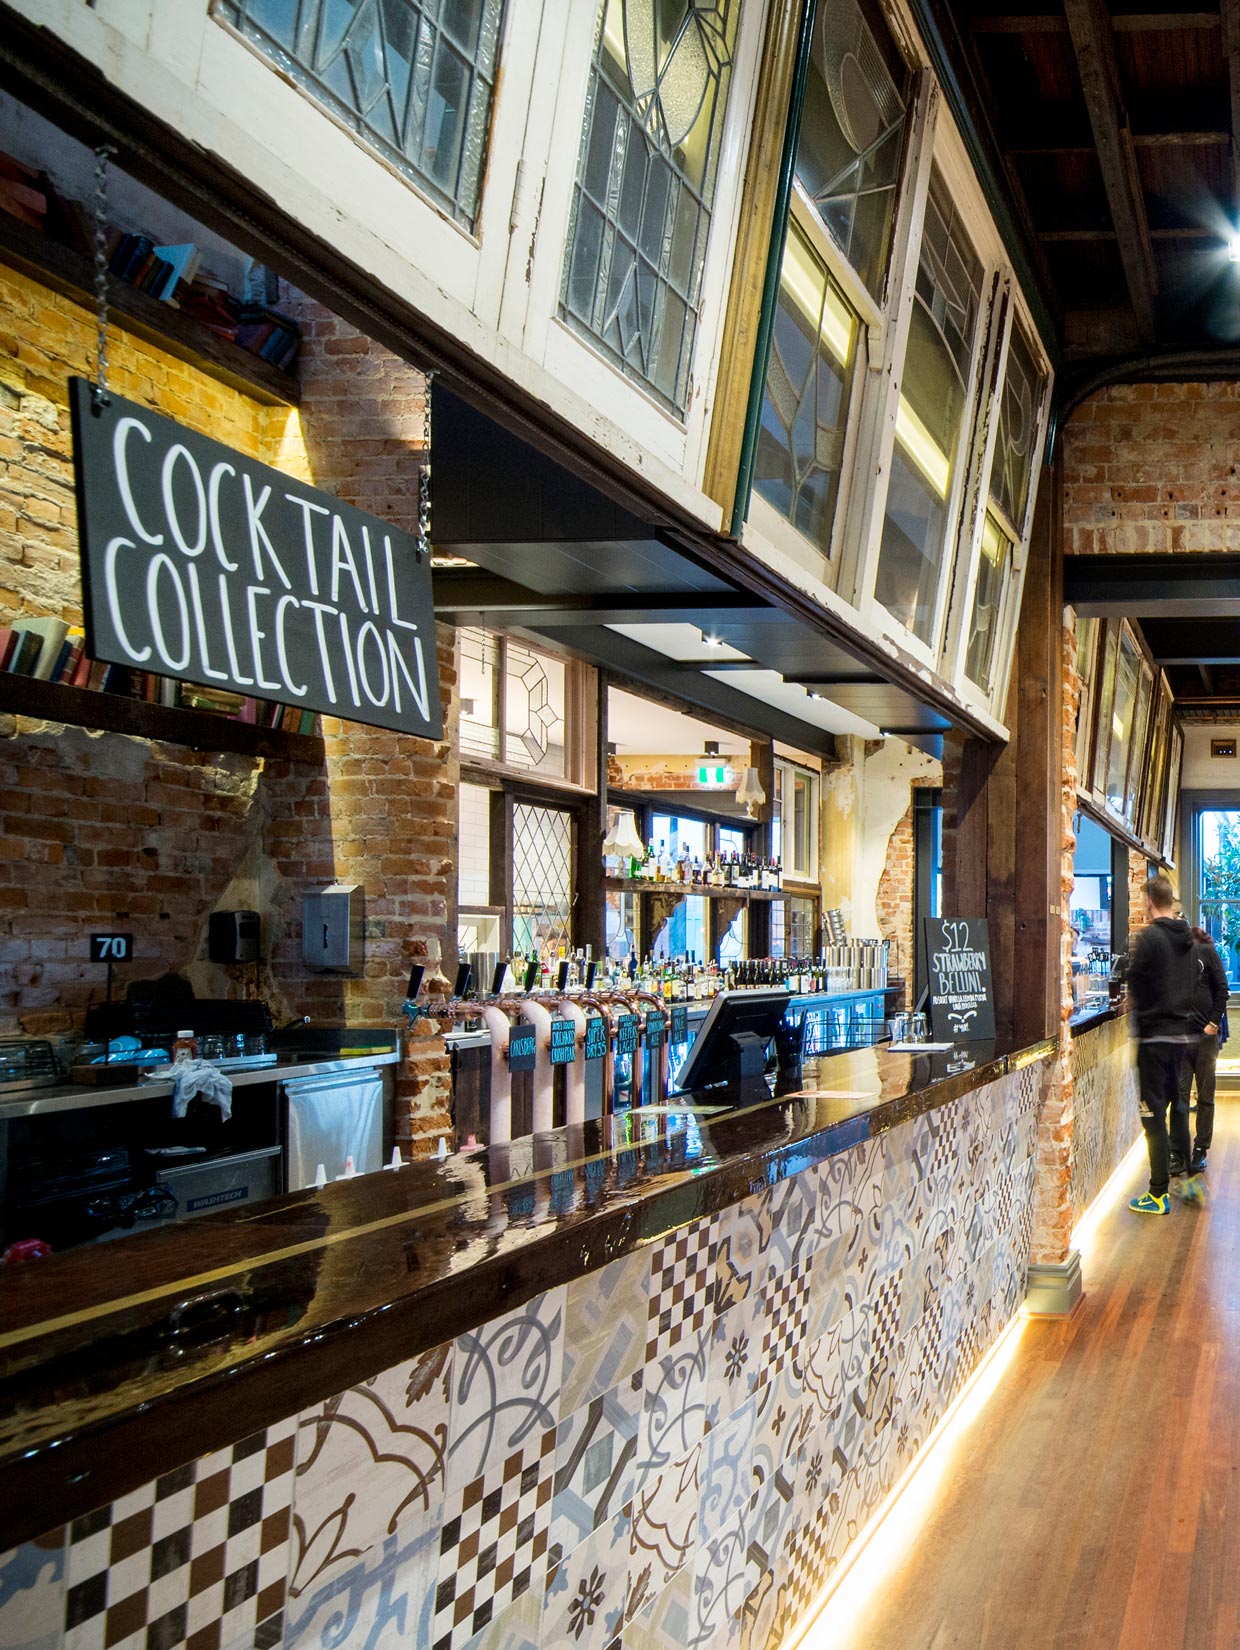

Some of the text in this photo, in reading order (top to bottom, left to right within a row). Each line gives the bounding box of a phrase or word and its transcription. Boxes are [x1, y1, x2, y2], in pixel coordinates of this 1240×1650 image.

[112, 416, 418, 631] COCKTAIL
[104, 536, 431, 723] COLLECTION
[941, 919, 974, 953] $12
[96, 937, 126, 958] 70
[932, 951, 987, 973] STRAWBERRY
[587, 1026, 606, 1045] SUPER
[619, 1039, 637, 1054] LAGER
[193, 1190, 242, 1208] WASHTECH
